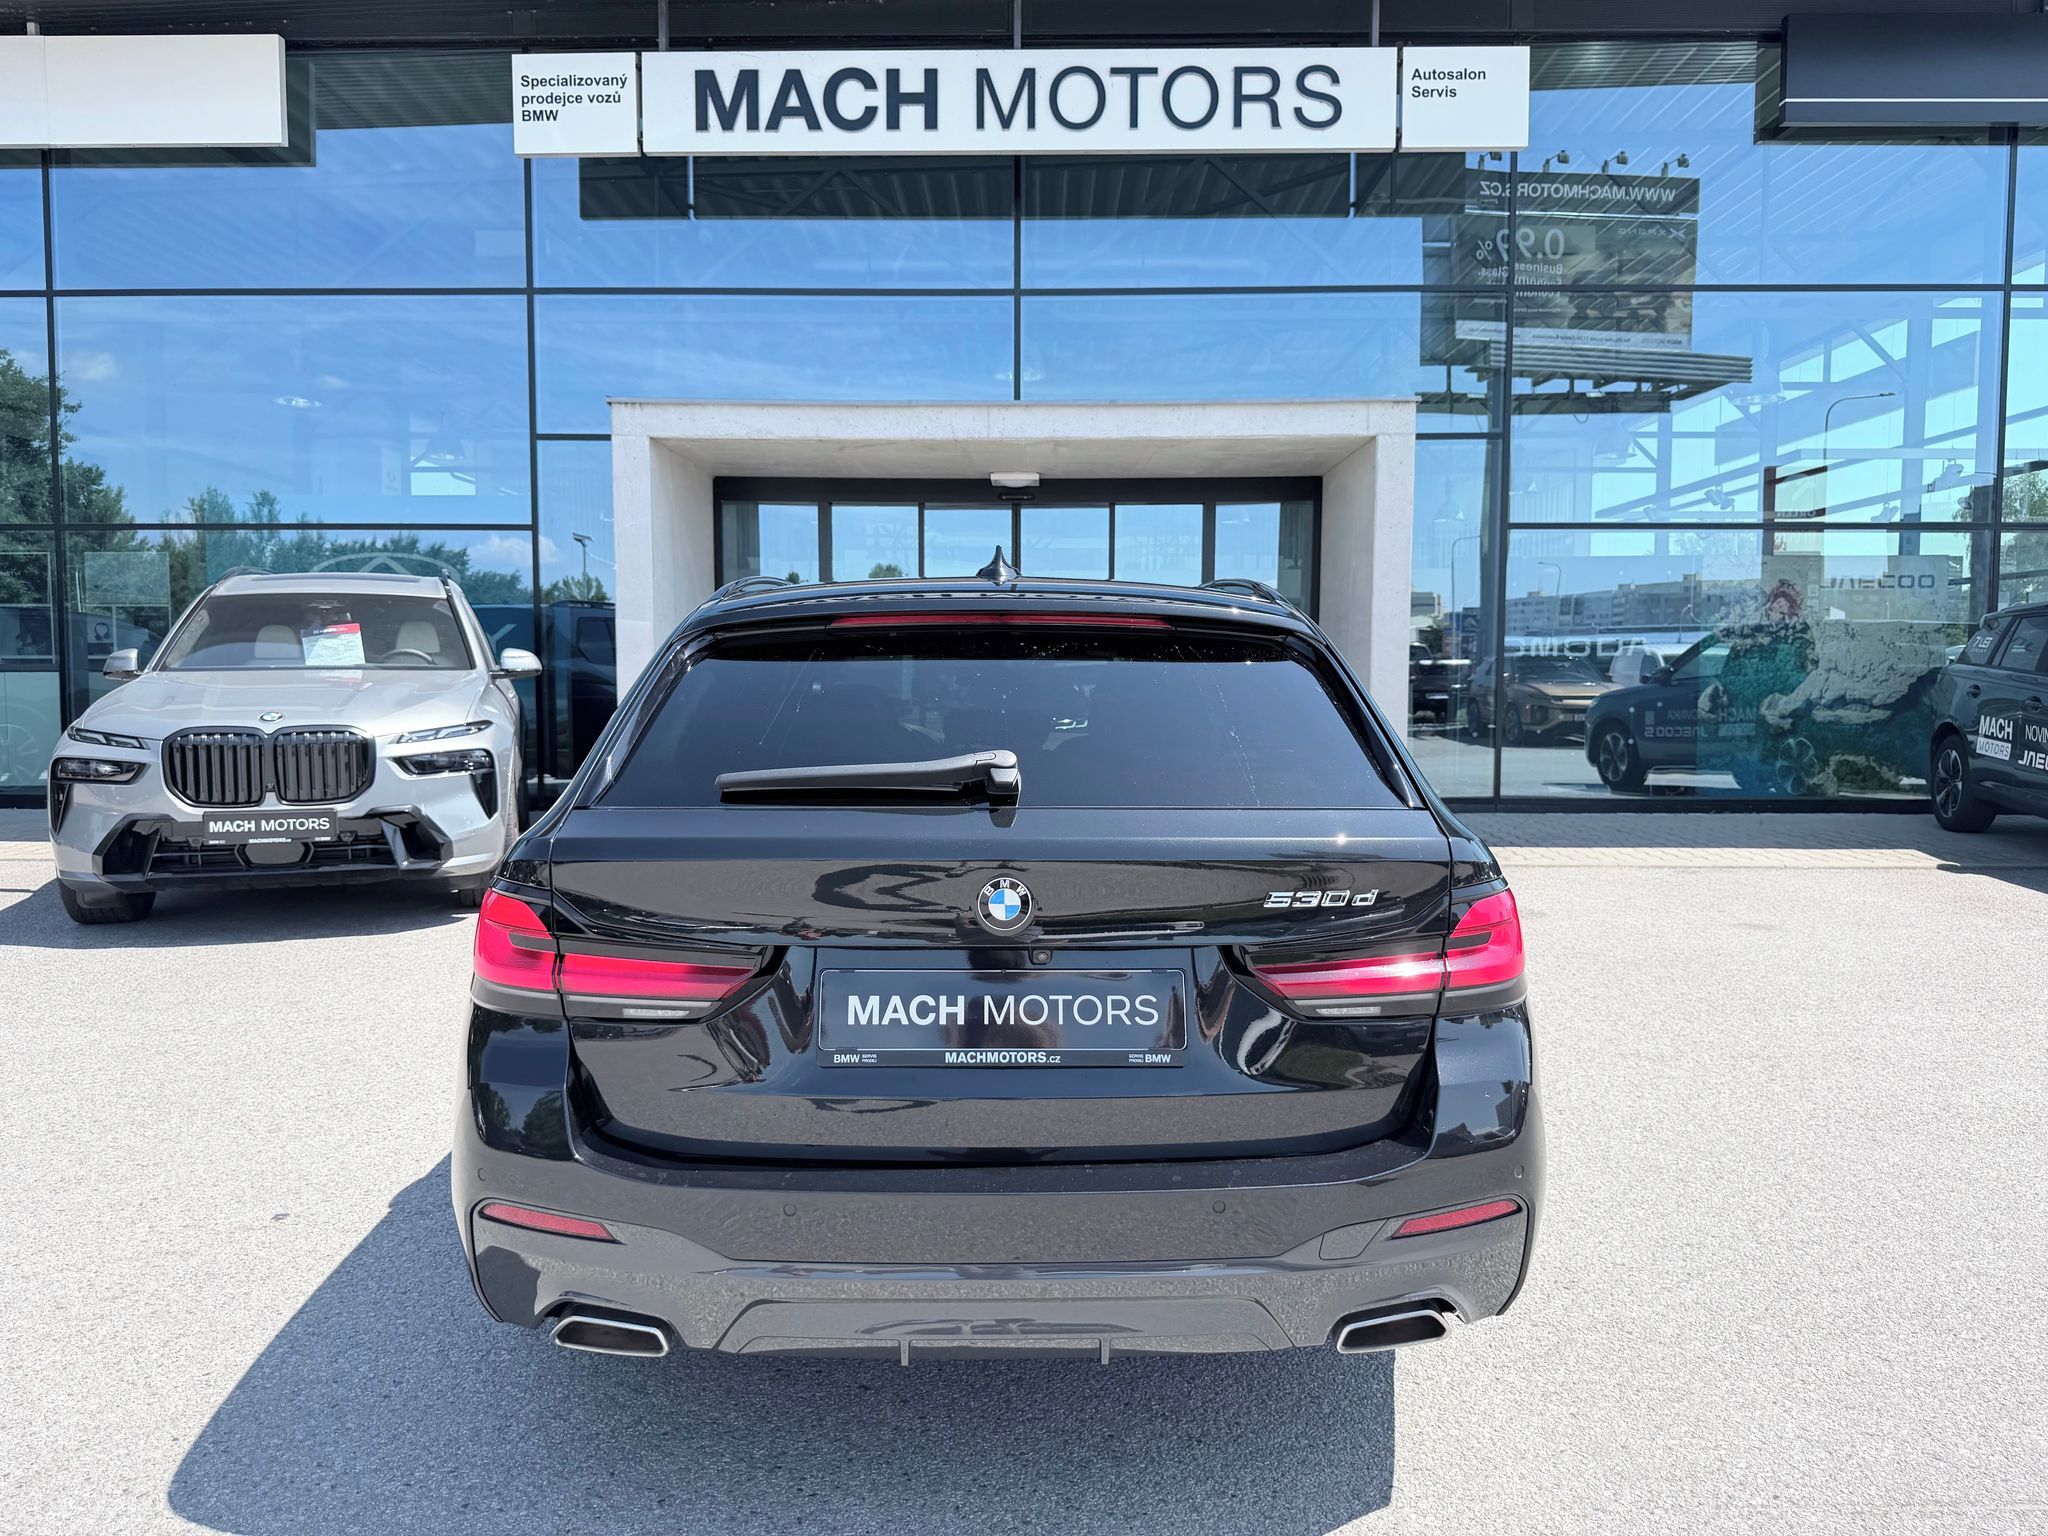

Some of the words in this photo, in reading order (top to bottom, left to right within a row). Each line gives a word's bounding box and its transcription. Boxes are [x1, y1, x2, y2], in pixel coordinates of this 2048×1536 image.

[520, 74, 628, 90] Specializovaný
[1411, 67, 1487, 81] Autosalon
[521, 92, 583, 107] prodejce
[587, 90, 621, 104] vozů
[694, 67, 939, 132] MACH
[975, 64, 1343, 131] MOTORS
[1411, 85, 1457, 98] Servis
[521, 109, 559, 122] BMW
[1979, 714, 2013, 741] MACH
[1977, 740, 2011, 758] MOTORS
[209, 820, 256, 833] MACH
[261, 817, 330, 831] MOTORS
[984, 879, 1027, 897] BMW
[847, 995, 965, 1025] MACH
[983, 994, 1160, 1025] MOTORS
[833, 1054, 860, 1064] BMW
[944, 1051, 1061, 1064] MACHMOTORS.cz
[1145, 1053, 1172, 1064] BMW
